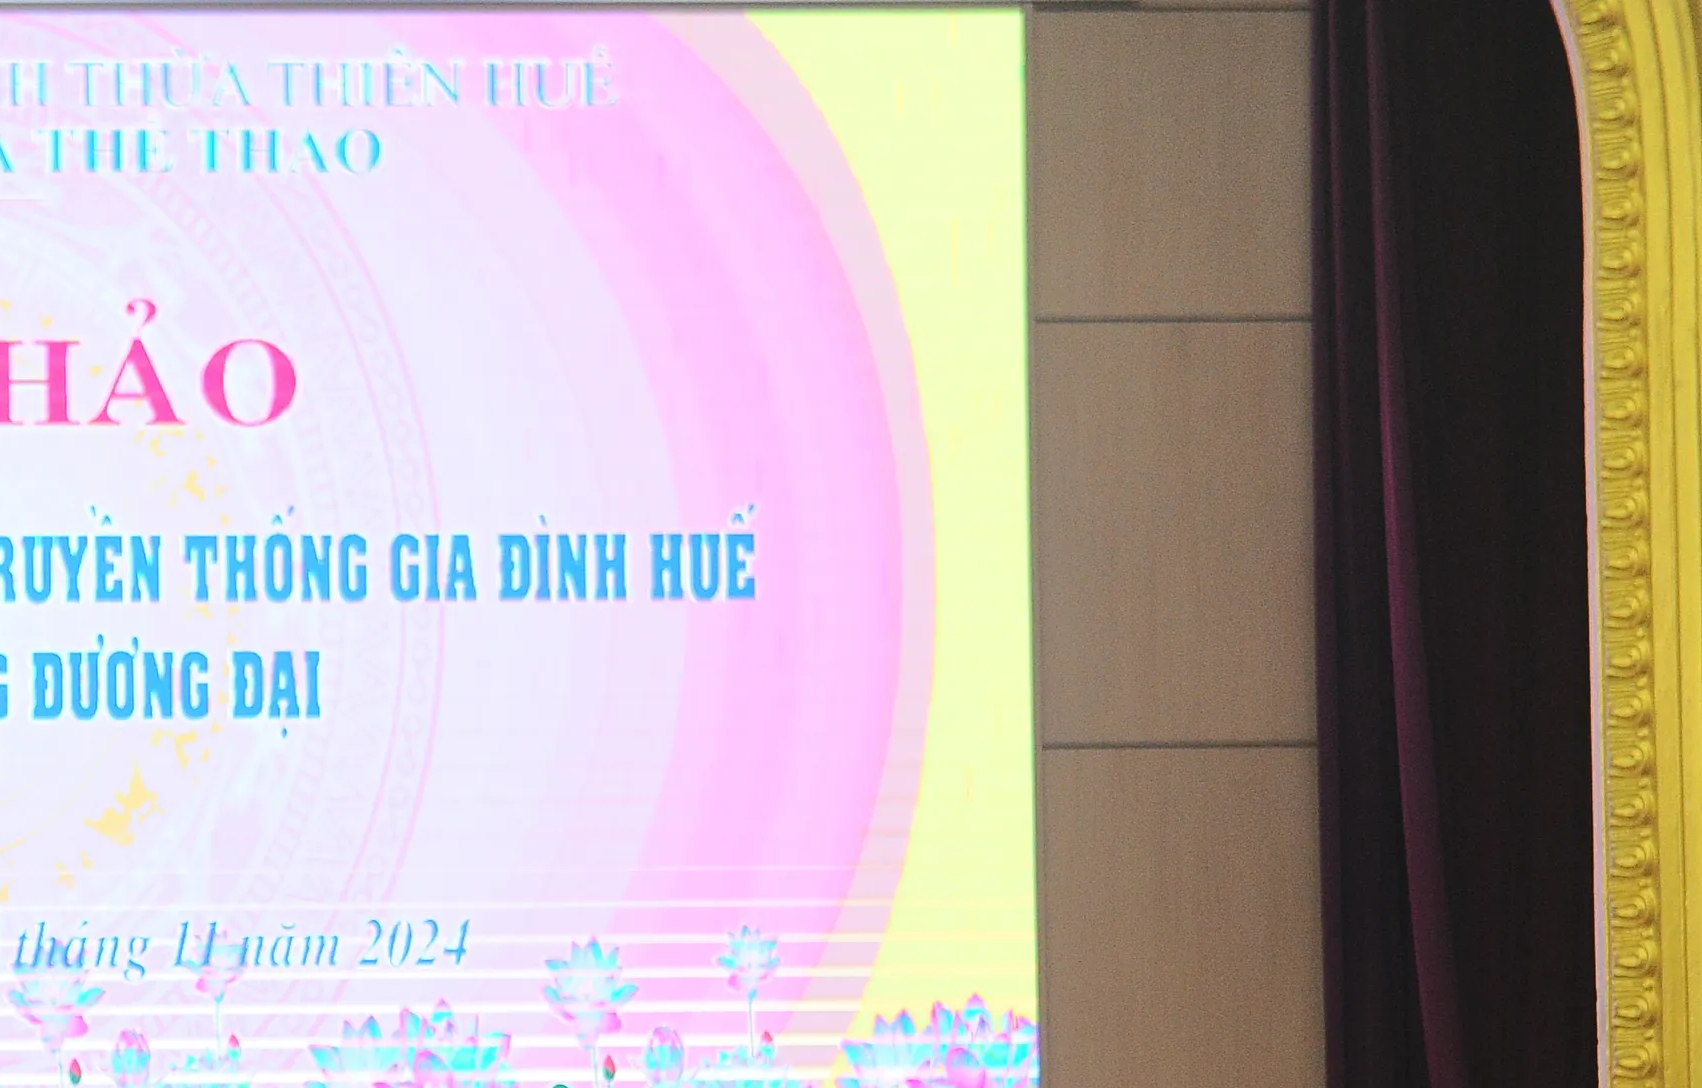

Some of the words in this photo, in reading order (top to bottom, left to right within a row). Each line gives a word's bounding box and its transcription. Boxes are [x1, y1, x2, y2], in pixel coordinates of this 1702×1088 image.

[188, 127, 383, 175] THAO
[184, 506, 368, 603] THỐNG
[390, 534, 477, 602] GIA
[499, 516, 628, 602] ĐÌNH
[649, 503, 757, 601] HUẾ
[32, 635, 210, 720] ĐƯƠNG
[232, 651, 321, 739] ĐẠI
[13, 920, 151, 981] tháng
[172, 920, 219, 968] 11
[239, 921, 341, 967] năm
[358, 918, 472, 967] 2024
